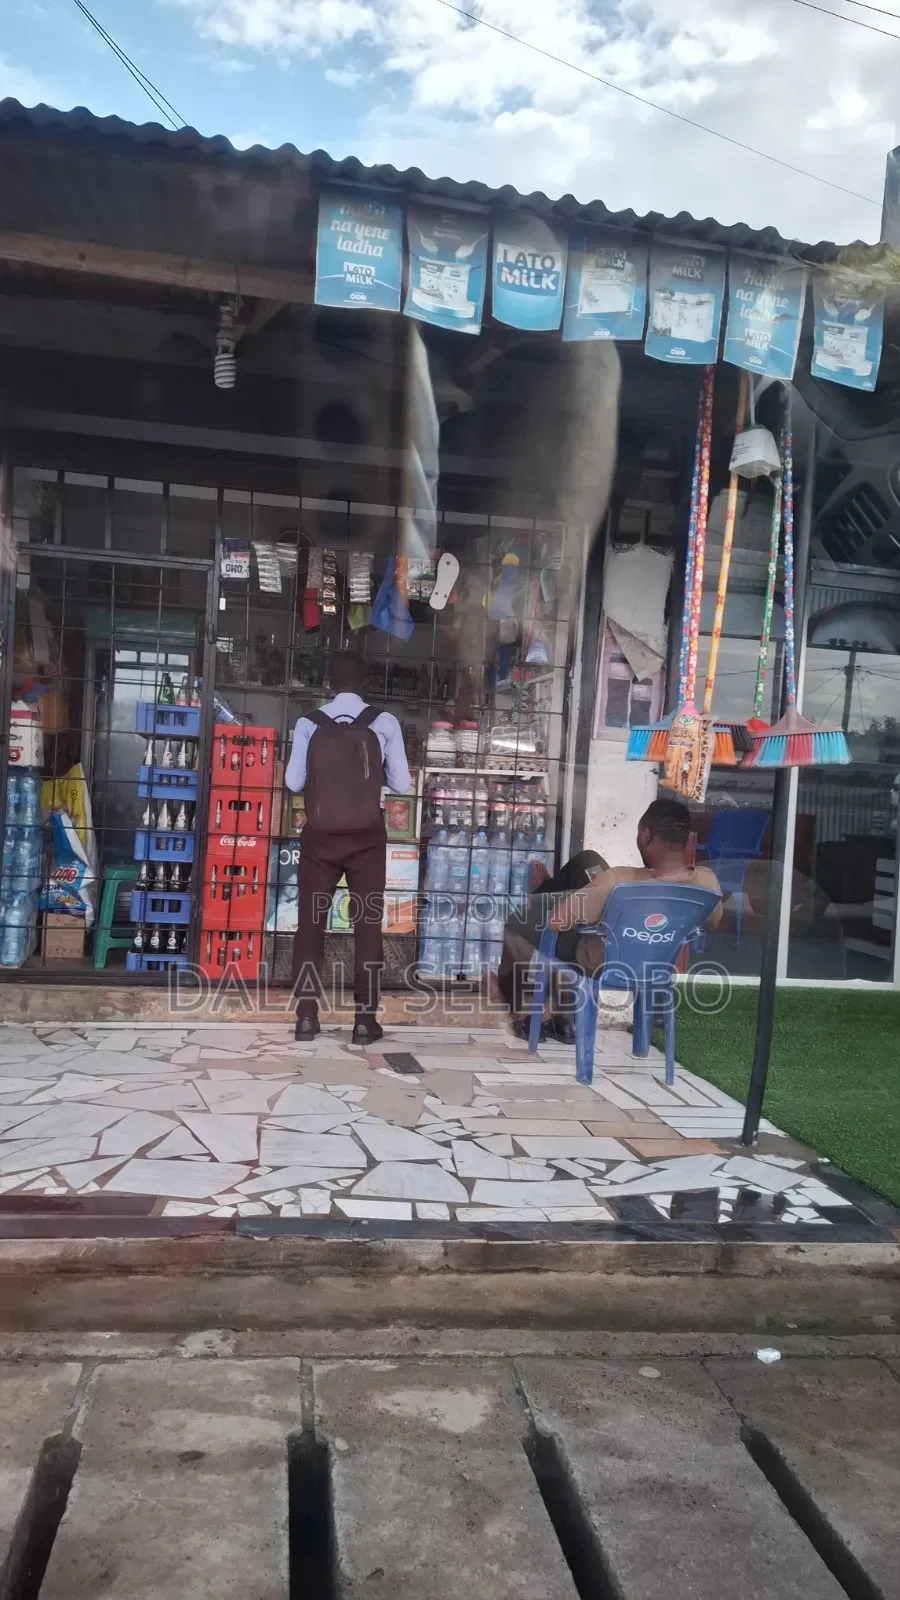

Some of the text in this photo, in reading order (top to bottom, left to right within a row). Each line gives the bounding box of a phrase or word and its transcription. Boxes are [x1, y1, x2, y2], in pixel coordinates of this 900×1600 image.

[330, 219, 391, 241] na yene
[336, 234, 386, 258] ladha
[346, 263, 373, 276] LATO
[502, 248, 556, 270] LATO
[500, 266, 557, 291] MiLK
[735, 288, 754, 302] na
[621, 927, 677, 945] pepsi
